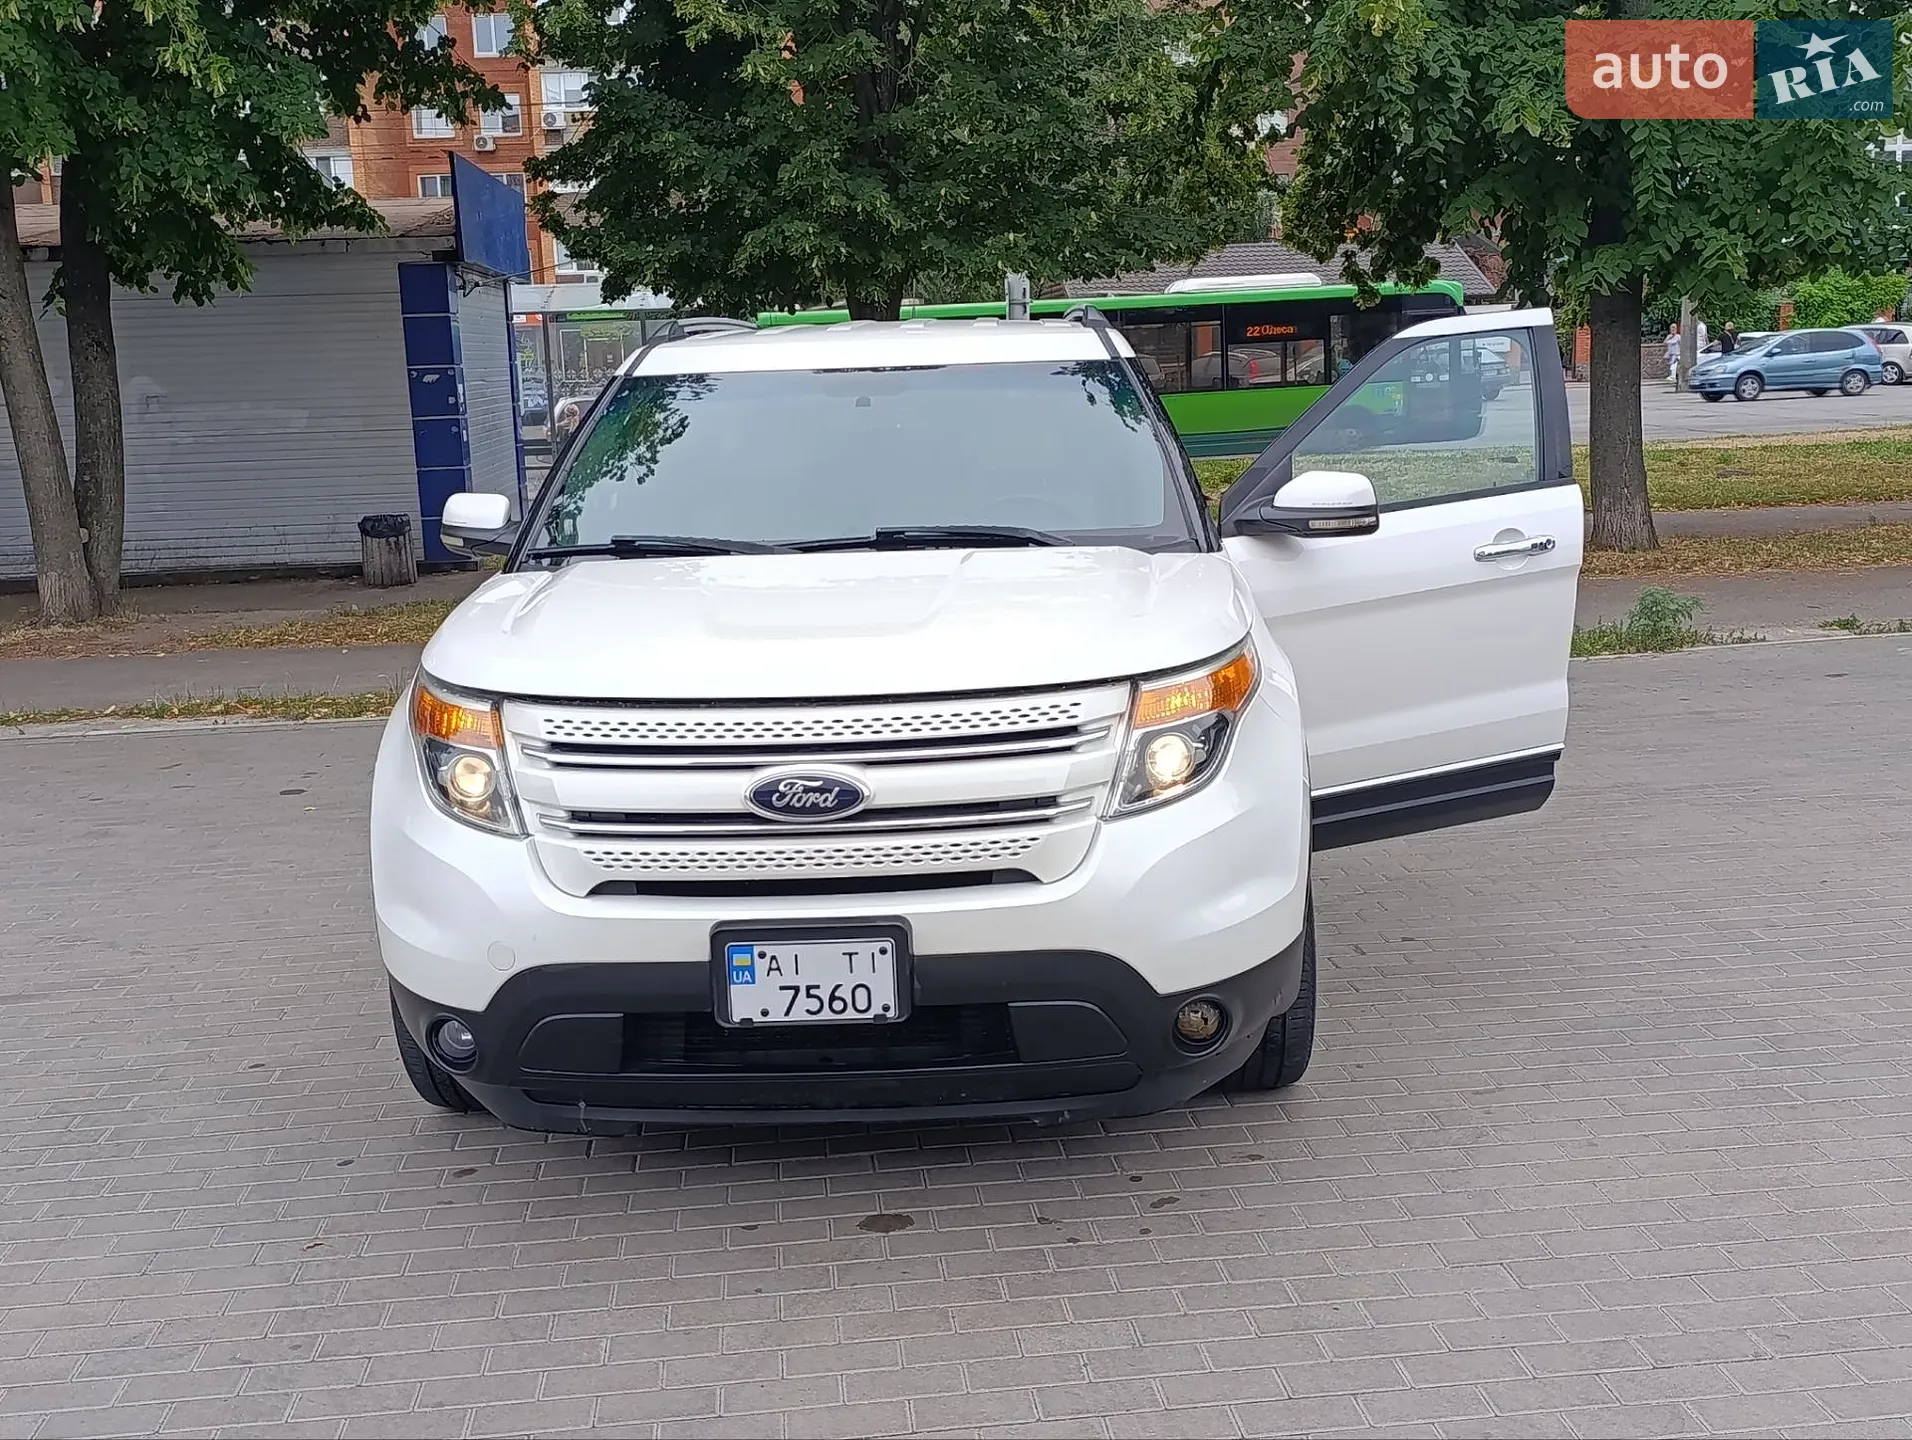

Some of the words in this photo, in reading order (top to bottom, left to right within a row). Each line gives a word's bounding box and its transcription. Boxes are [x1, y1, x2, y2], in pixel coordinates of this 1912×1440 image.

[1246, 326, 1261, 337] 22
[771, 779, 841, 808] Ford
[732, 969, 753, 984] UA
[766, 953, 800, 978] AI
[841, 951, 877, 975] TI
[778, 982, 873, 1017] 7560
